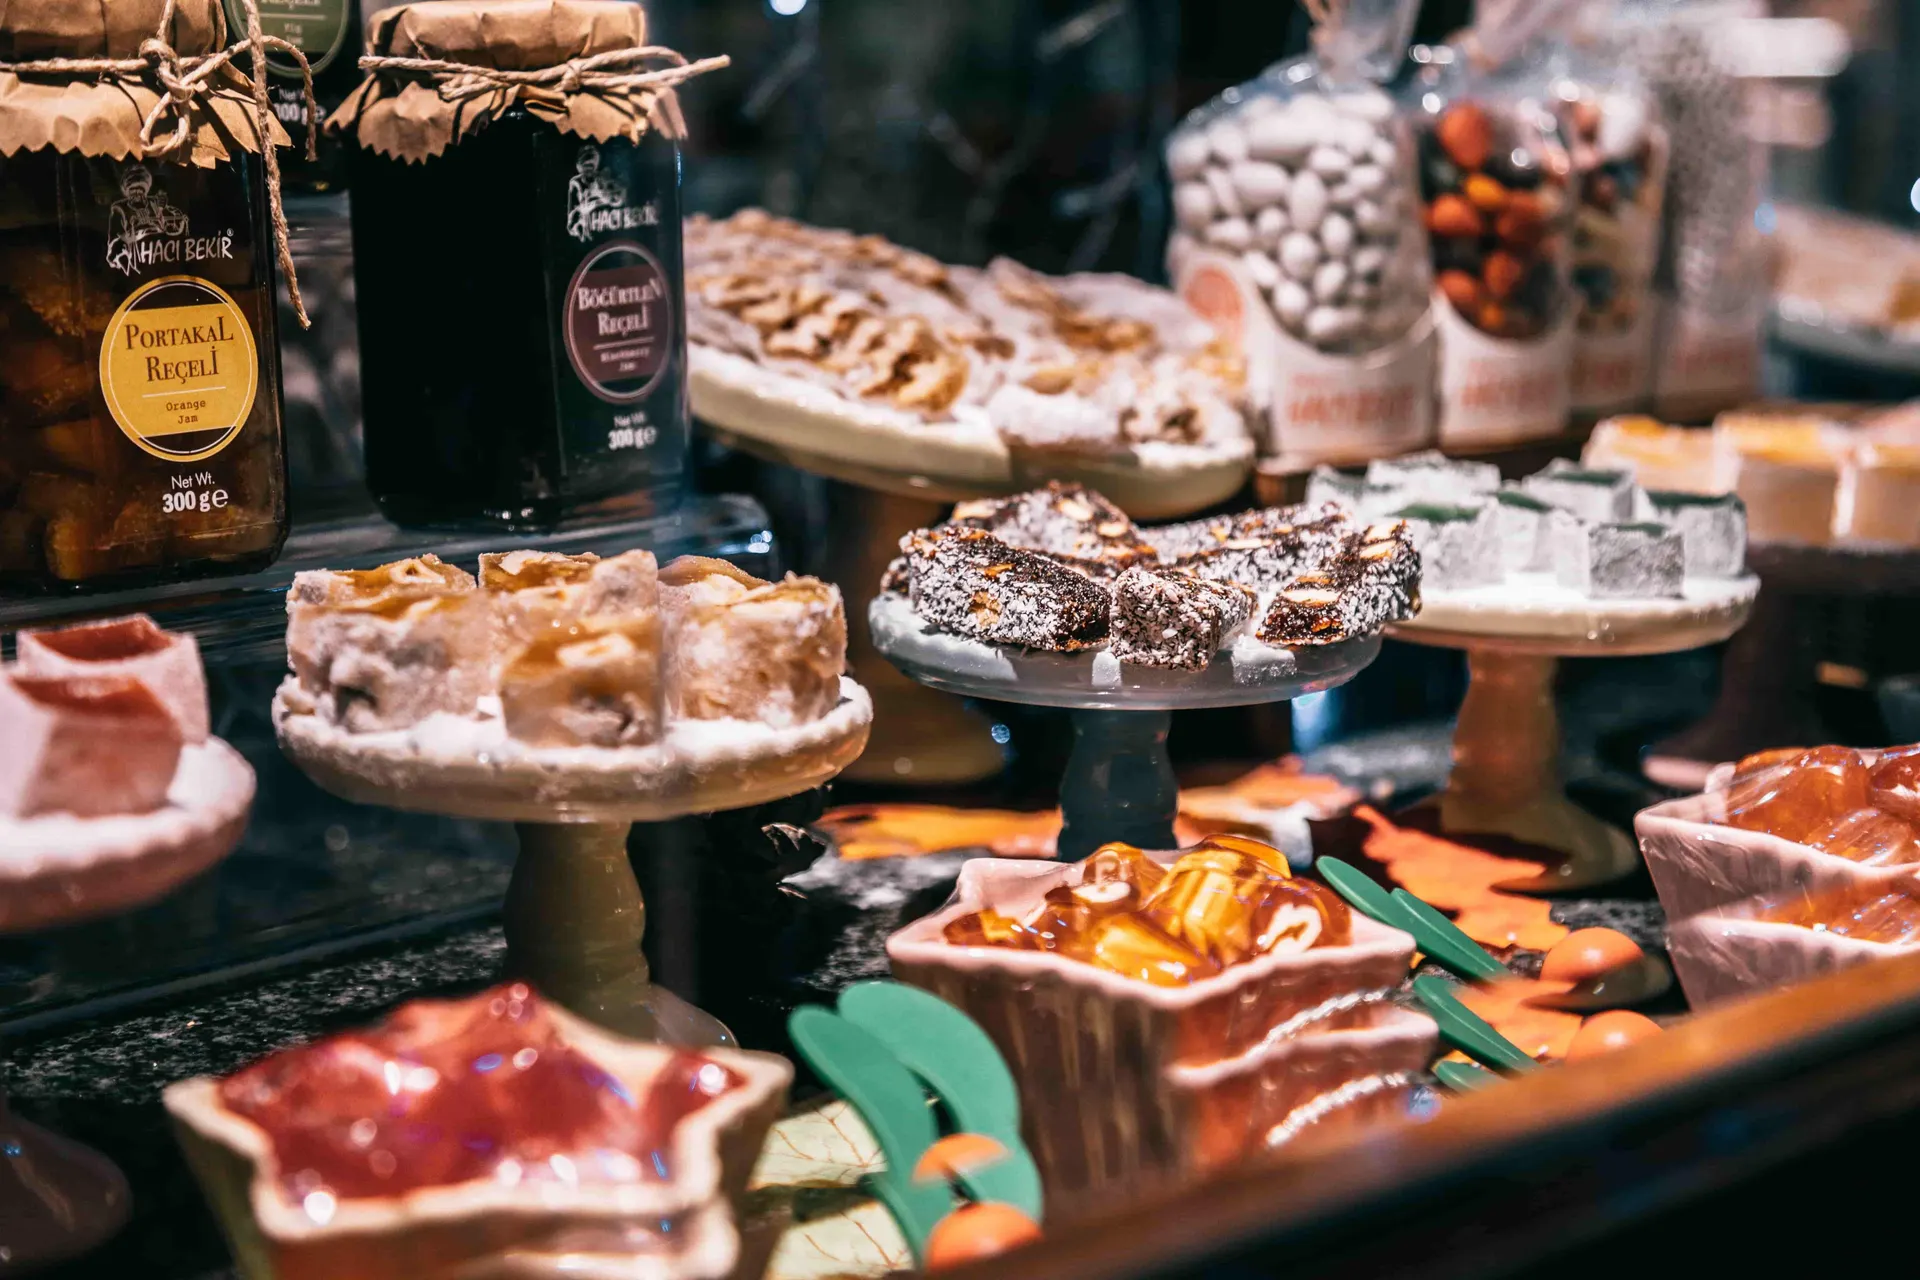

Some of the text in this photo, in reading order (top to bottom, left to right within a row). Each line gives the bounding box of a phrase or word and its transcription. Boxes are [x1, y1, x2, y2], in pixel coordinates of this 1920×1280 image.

[591, 208, 620, 231] HACI
[140, 230, 233, 265] HACI BEKİR
[124, 315, 234, 350] PORTAKAL
[145, 345, 219, 385] REÇELİ
[165, 400, 206, 412] Orange
[177, 415, 198, 425] Jam
[607, 428, 634, 451] 300
[171, 471, 216, 490] Net Wt.
[162, 490, 197, 513] 300
